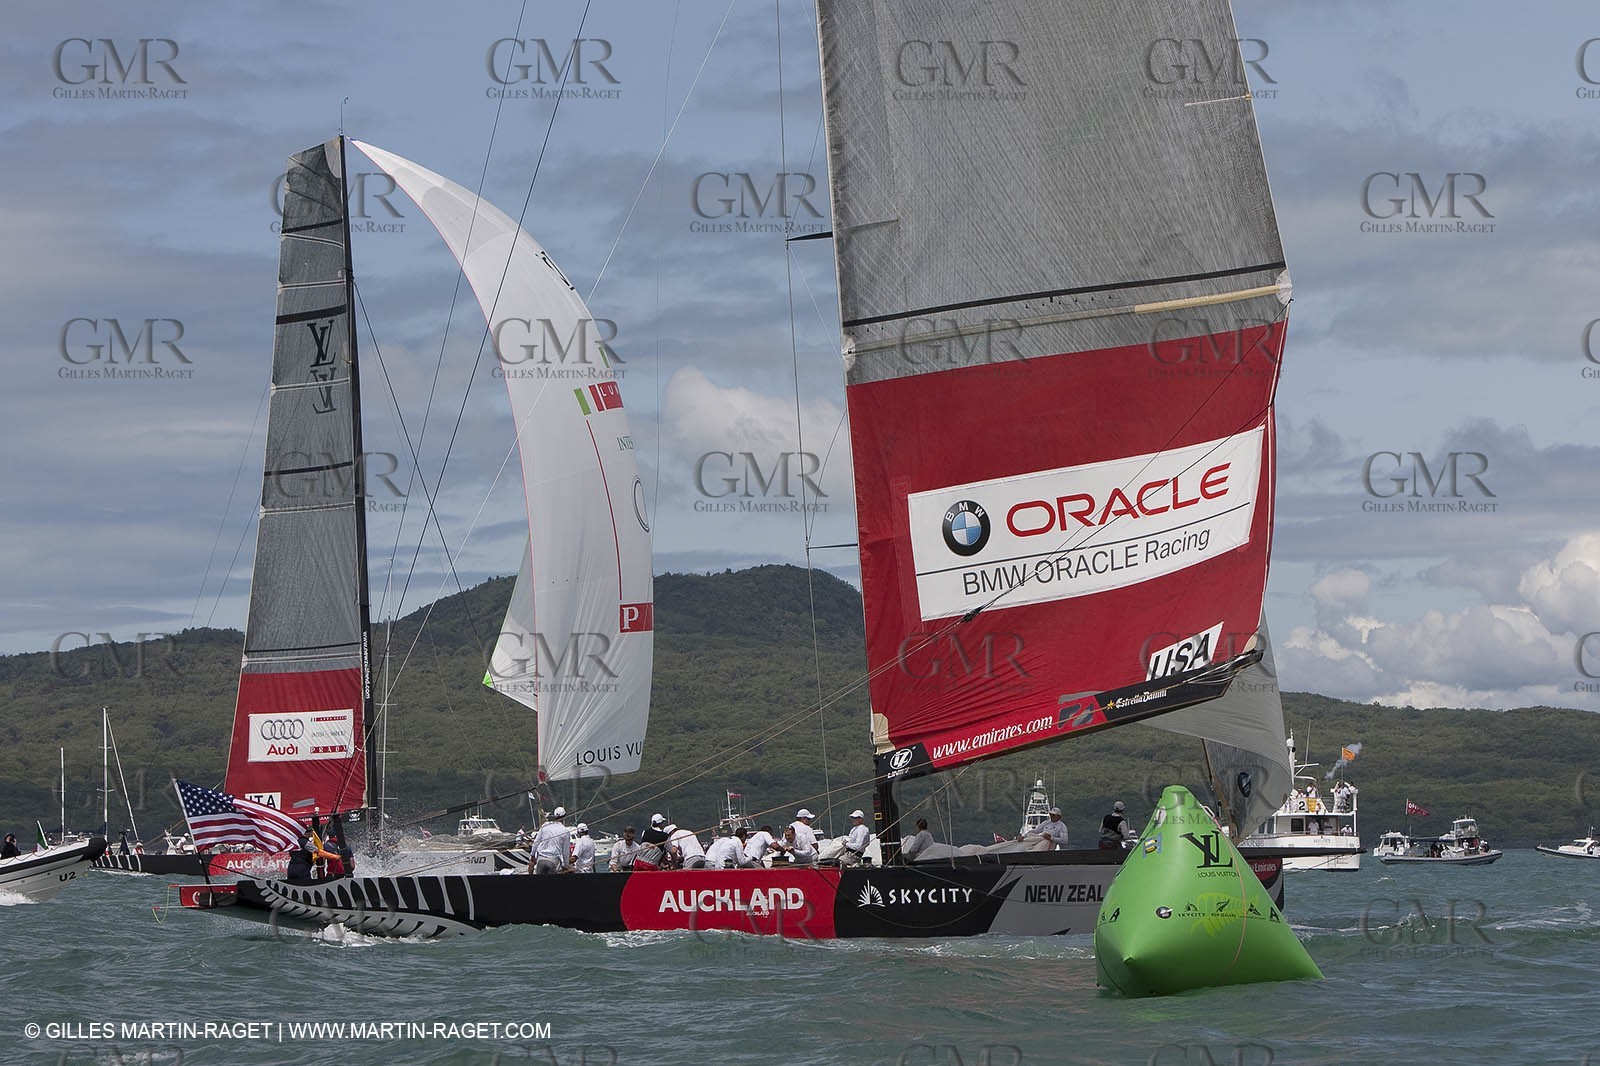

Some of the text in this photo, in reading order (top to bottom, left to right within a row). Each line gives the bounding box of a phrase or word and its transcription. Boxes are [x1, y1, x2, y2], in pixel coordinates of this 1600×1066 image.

[1006, 463, 1232, 537] ORACLE
[945, 501, 986, 521] BMW
[963, 528, 1211, 596] BMW ORACLE Racing
[1151, 633, 1211, 680] USA
[933, 715, 1054, 760] www.emirates.com
[266, 743, 299, 756] Audi
[576, 745, 621, 766] LOUIS
[59, 871, 77, 882] U2
[658, 888, 805, 913] AUCKLAND
[888, 888, 973, 905] SKYCITY
[1024, 884, 1066, 903] NEW
